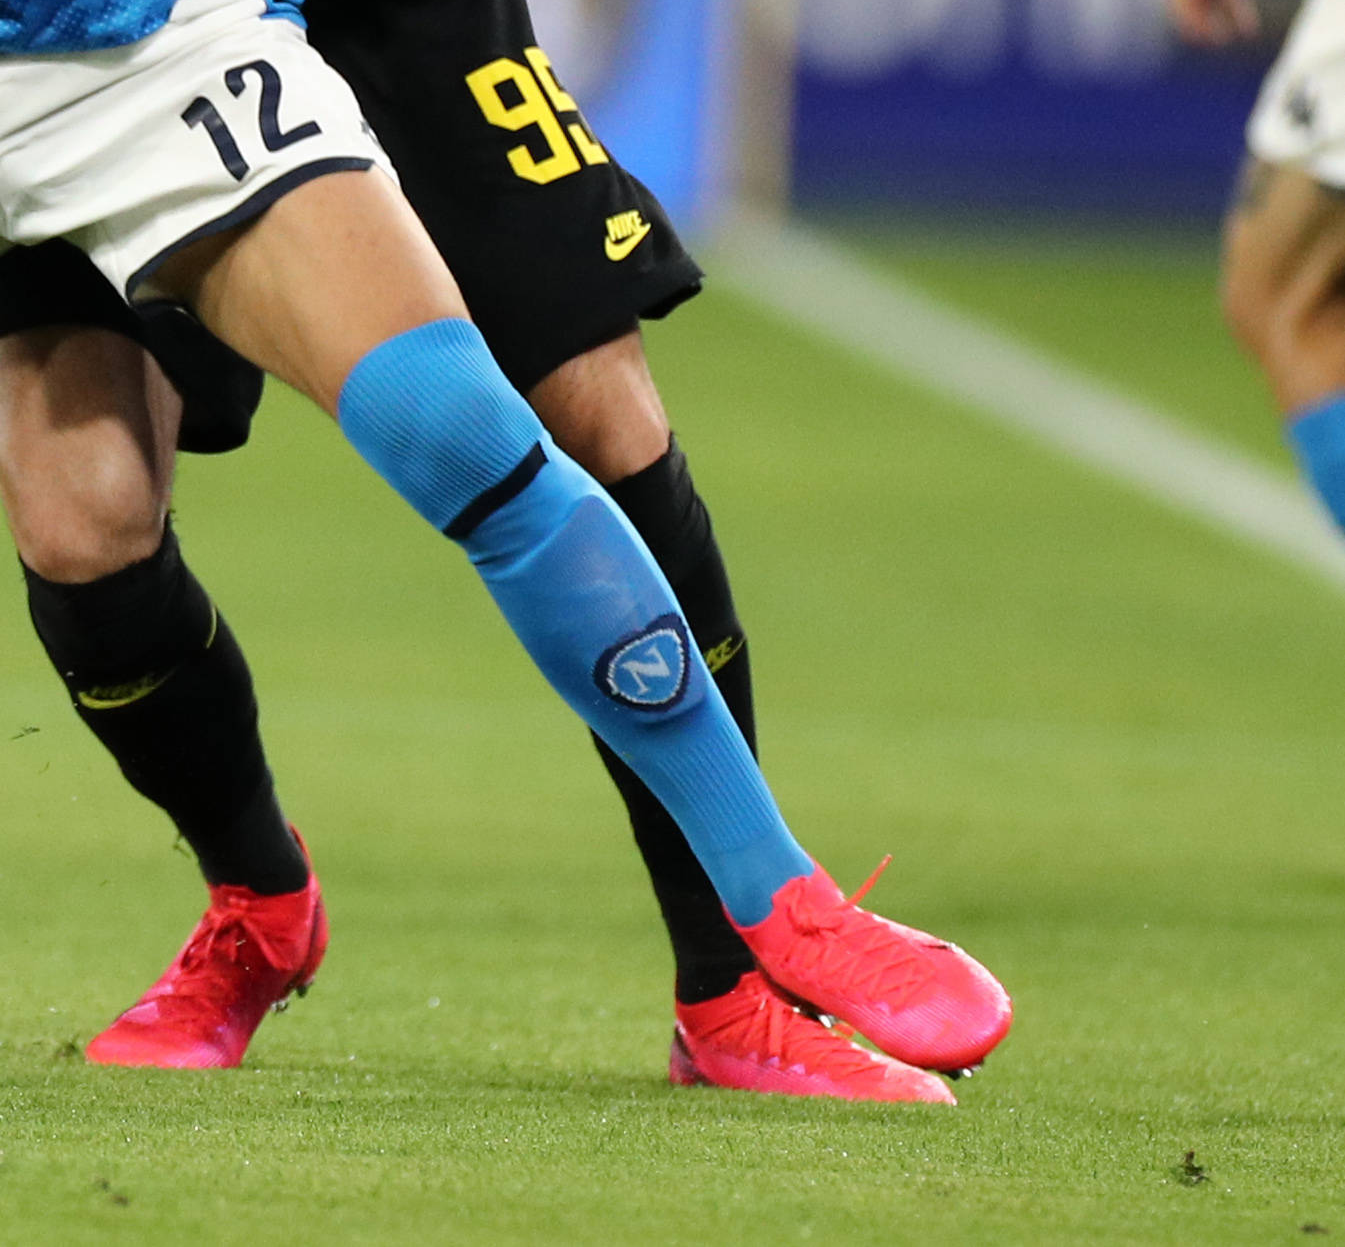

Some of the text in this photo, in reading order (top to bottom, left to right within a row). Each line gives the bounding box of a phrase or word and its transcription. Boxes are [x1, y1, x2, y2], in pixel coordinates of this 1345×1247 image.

[180, 59, 323, 182] 12
[605, 209, 643, 242] NIKE
[621, 644, 671, 694] N
